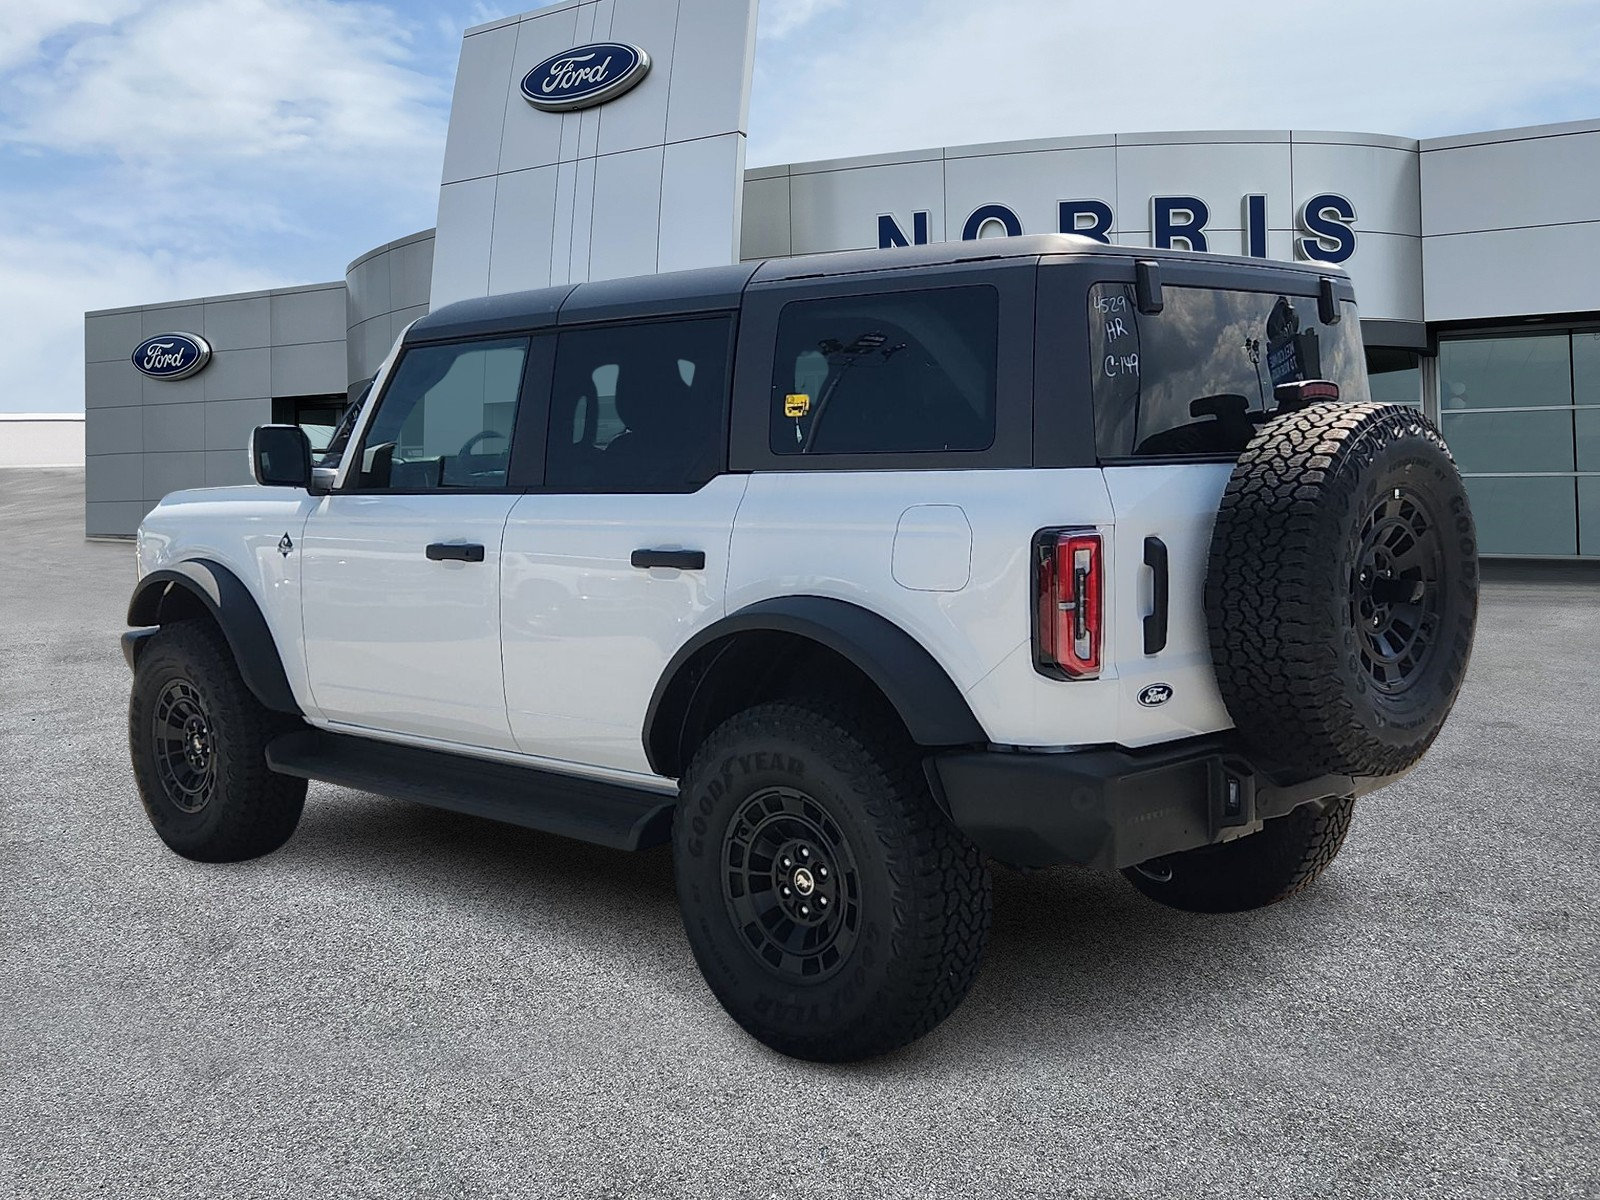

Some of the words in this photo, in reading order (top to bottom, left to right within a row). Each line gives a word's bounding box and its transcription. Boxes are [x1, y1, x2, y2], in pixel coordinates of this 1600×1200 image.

[542, 53, 612, 93] Ford
[877, 192, 1358, 264] NORRIS
[1093, 295, 1127, 314] 4529
[1105, 318, 1129, 343] HR
[143, 342, 185, 370] Ford
[1104, 353, 1140, 377] C-149
[1145, 687, 1169, 704] Ford
[688, 751, 806, 857] GOODYEAR
